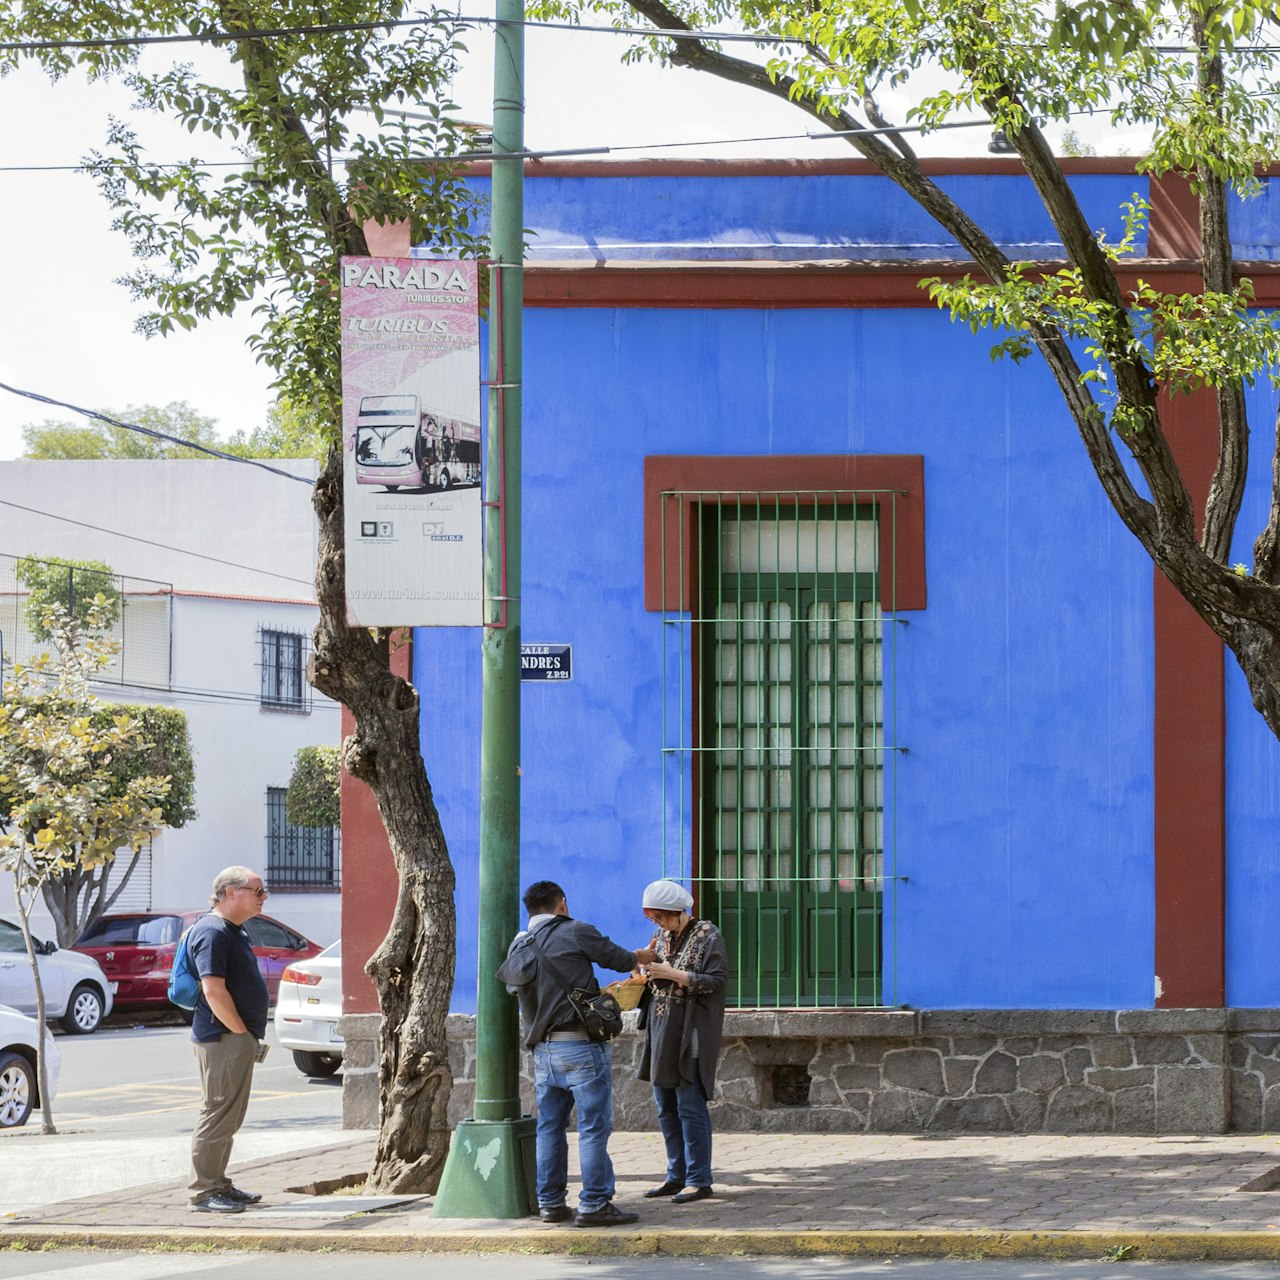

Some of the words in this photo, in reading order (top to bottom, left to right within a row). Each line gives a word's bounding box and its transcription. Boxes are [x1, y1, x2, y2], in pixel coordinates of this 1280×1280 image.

[343, 265, 468, 291] PARADA
[406, 294, 444, 303] TURIBUS
[446, 294, 470, 304] STOP
